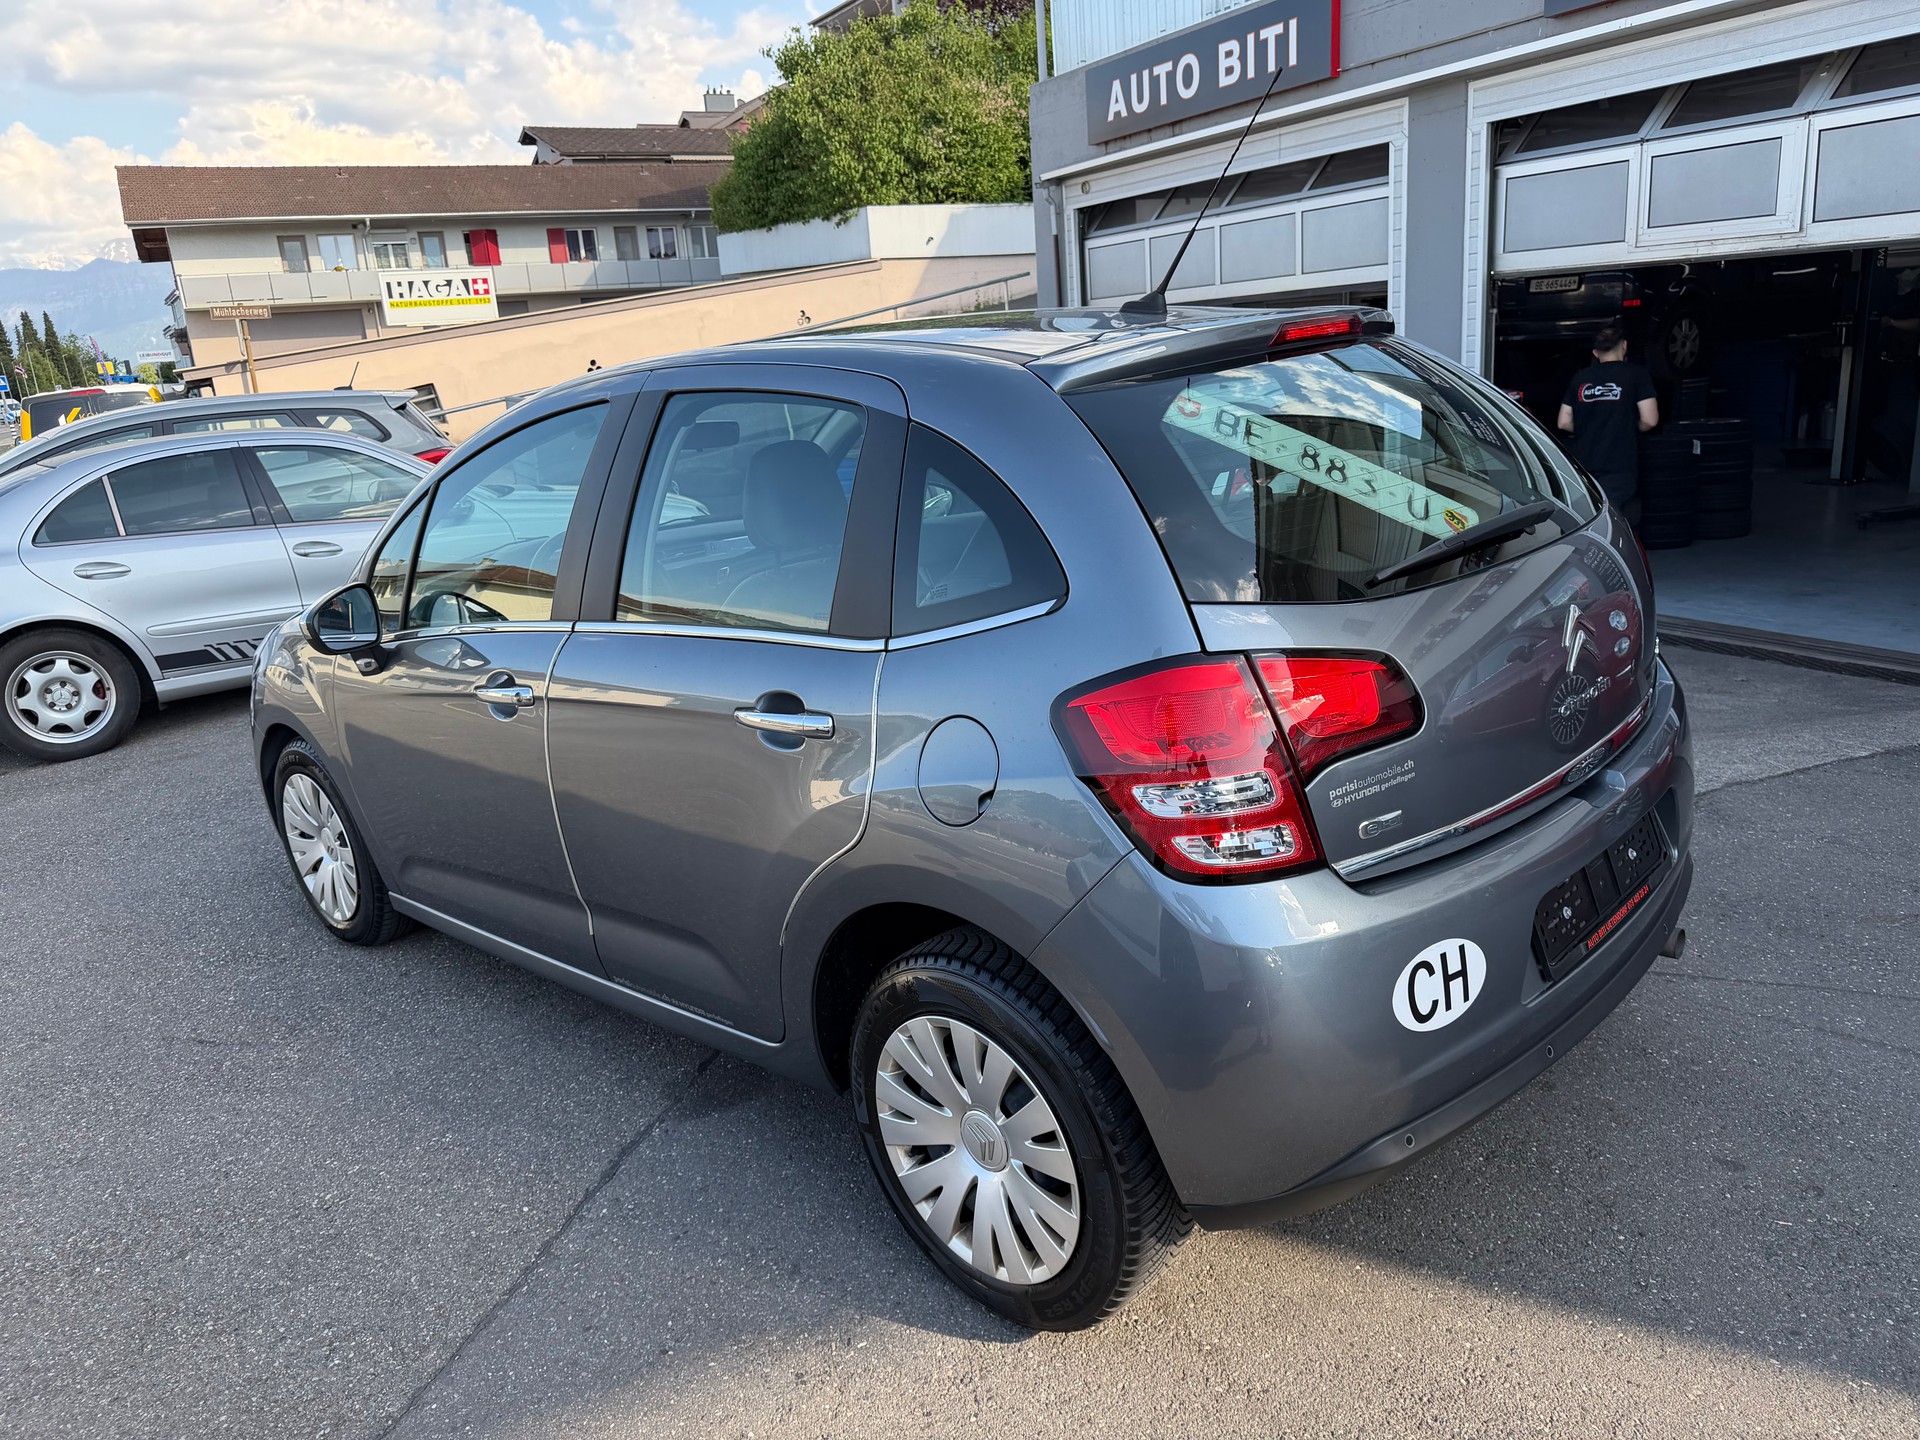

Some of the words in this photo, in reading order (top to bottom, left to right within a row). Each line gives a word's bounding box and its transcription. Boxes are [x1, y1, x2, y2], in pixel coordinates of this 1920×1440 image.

[1107, 53, 1200, 122] AUTO
[1218, 17, 1298, 88] BITI
[387, 279, 471, 299] HAGA
[390, 300, 453, 308] NATURBAUSTOFFE
[213, 306, 269, 317] Mühlacherweg
[1329, 760, 1415, 800] parisiautomobile.ch
[1344, 784, 1380, 804] HYUNDAI
[1381, 772, 1415, 791] gerlafingen
[1408, 943, 1470, 1024] CH
